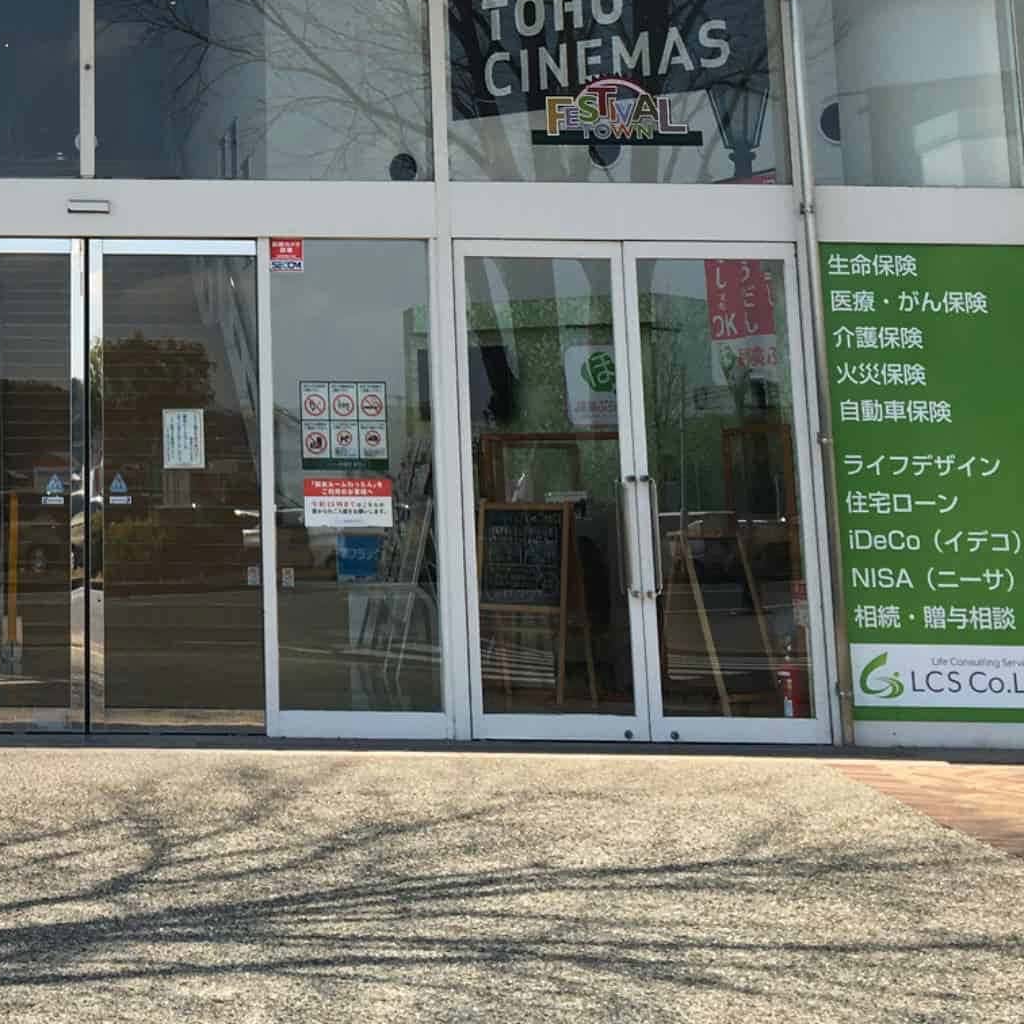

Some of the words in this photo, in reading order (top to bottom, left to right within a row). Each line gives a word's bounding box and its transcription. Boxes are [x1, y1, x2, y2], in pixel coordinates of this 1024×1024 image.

[484, 20, 730, 97] CINEMAS
[827, 254, 918, 277] 生命保険
[830, 290, 989, 314] 医療・がん保険
[832, 326, 924, 349] 介護保険
[836, 362, 927, 385] 火災保険
[839, 399, 953, 423] 自動車保険
[843, 454, 1001, 477] ライフデザイン
[846, 490, 958, 514] 住宅ローン
[854, 605, 1017, 630] 相続・贈与相談
[911, 671, 962, 694] LCS
